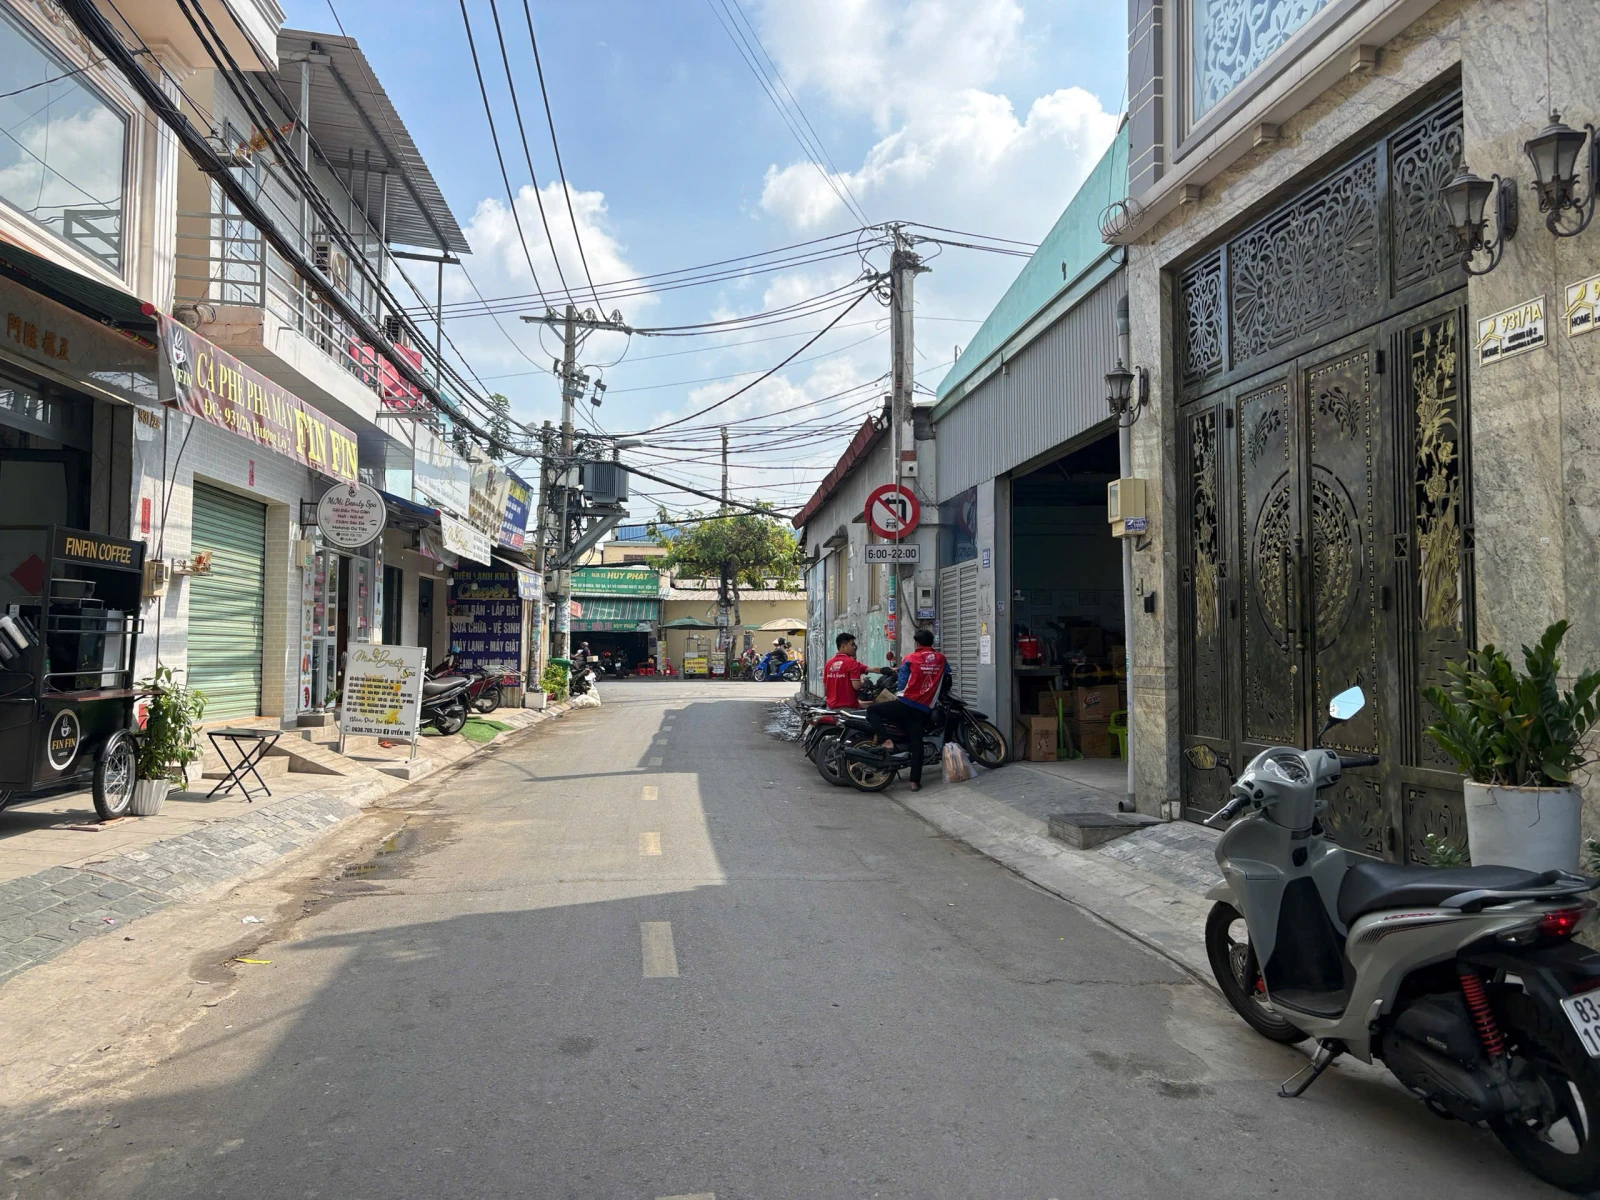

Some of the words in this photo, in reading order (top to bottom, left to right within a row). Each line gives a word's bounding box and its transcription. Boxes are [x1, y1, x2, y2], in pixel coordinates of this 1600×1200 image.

[1502, 304, 1543, 333] 931/1A
[1571, 312, 1591, 328] HOME
[1482, 345, 1500, 359] HOME
[196, 346, 216, 394] CÀ
[218, 363, 245, 408] PHÊ
[246, 379, 272, 421] PHA
[271, 391, 294, 433] MÁY
[293, 407, 328, 470] FIN
[329, 428, 359, 483] FIN
[344, 497, 365, 509] Beauty
[365, 499, 377, 510] Spa
[65, 537, 98, 560] FINFIN
[98, 543, 133, 565] COFFEE
[868, 548, 917, 559] 6:00-22:00
[606, 572, 626, 580] HUY
[626, 571, 650, 581] PHÁT
[457, 583, 510, 602] Chuyên
[471, 602, 486, 616] BÁN
[491, 601, 505, 616] LẮP
[506, 603, 520, 619] ĐẶT
[468, 620, 487, 634] CHỮA
[493, 620, 503, 636] VỆ
[503, 622, 521, 634] SINH
[467, 641, 485, 654] LẠNH
[489, 639, 504, 652] MÁY
[504, 639, 520, 654] GIẶT
[52, 740, 64, 751] FIN
[64, 737, 77, 748] FIN
